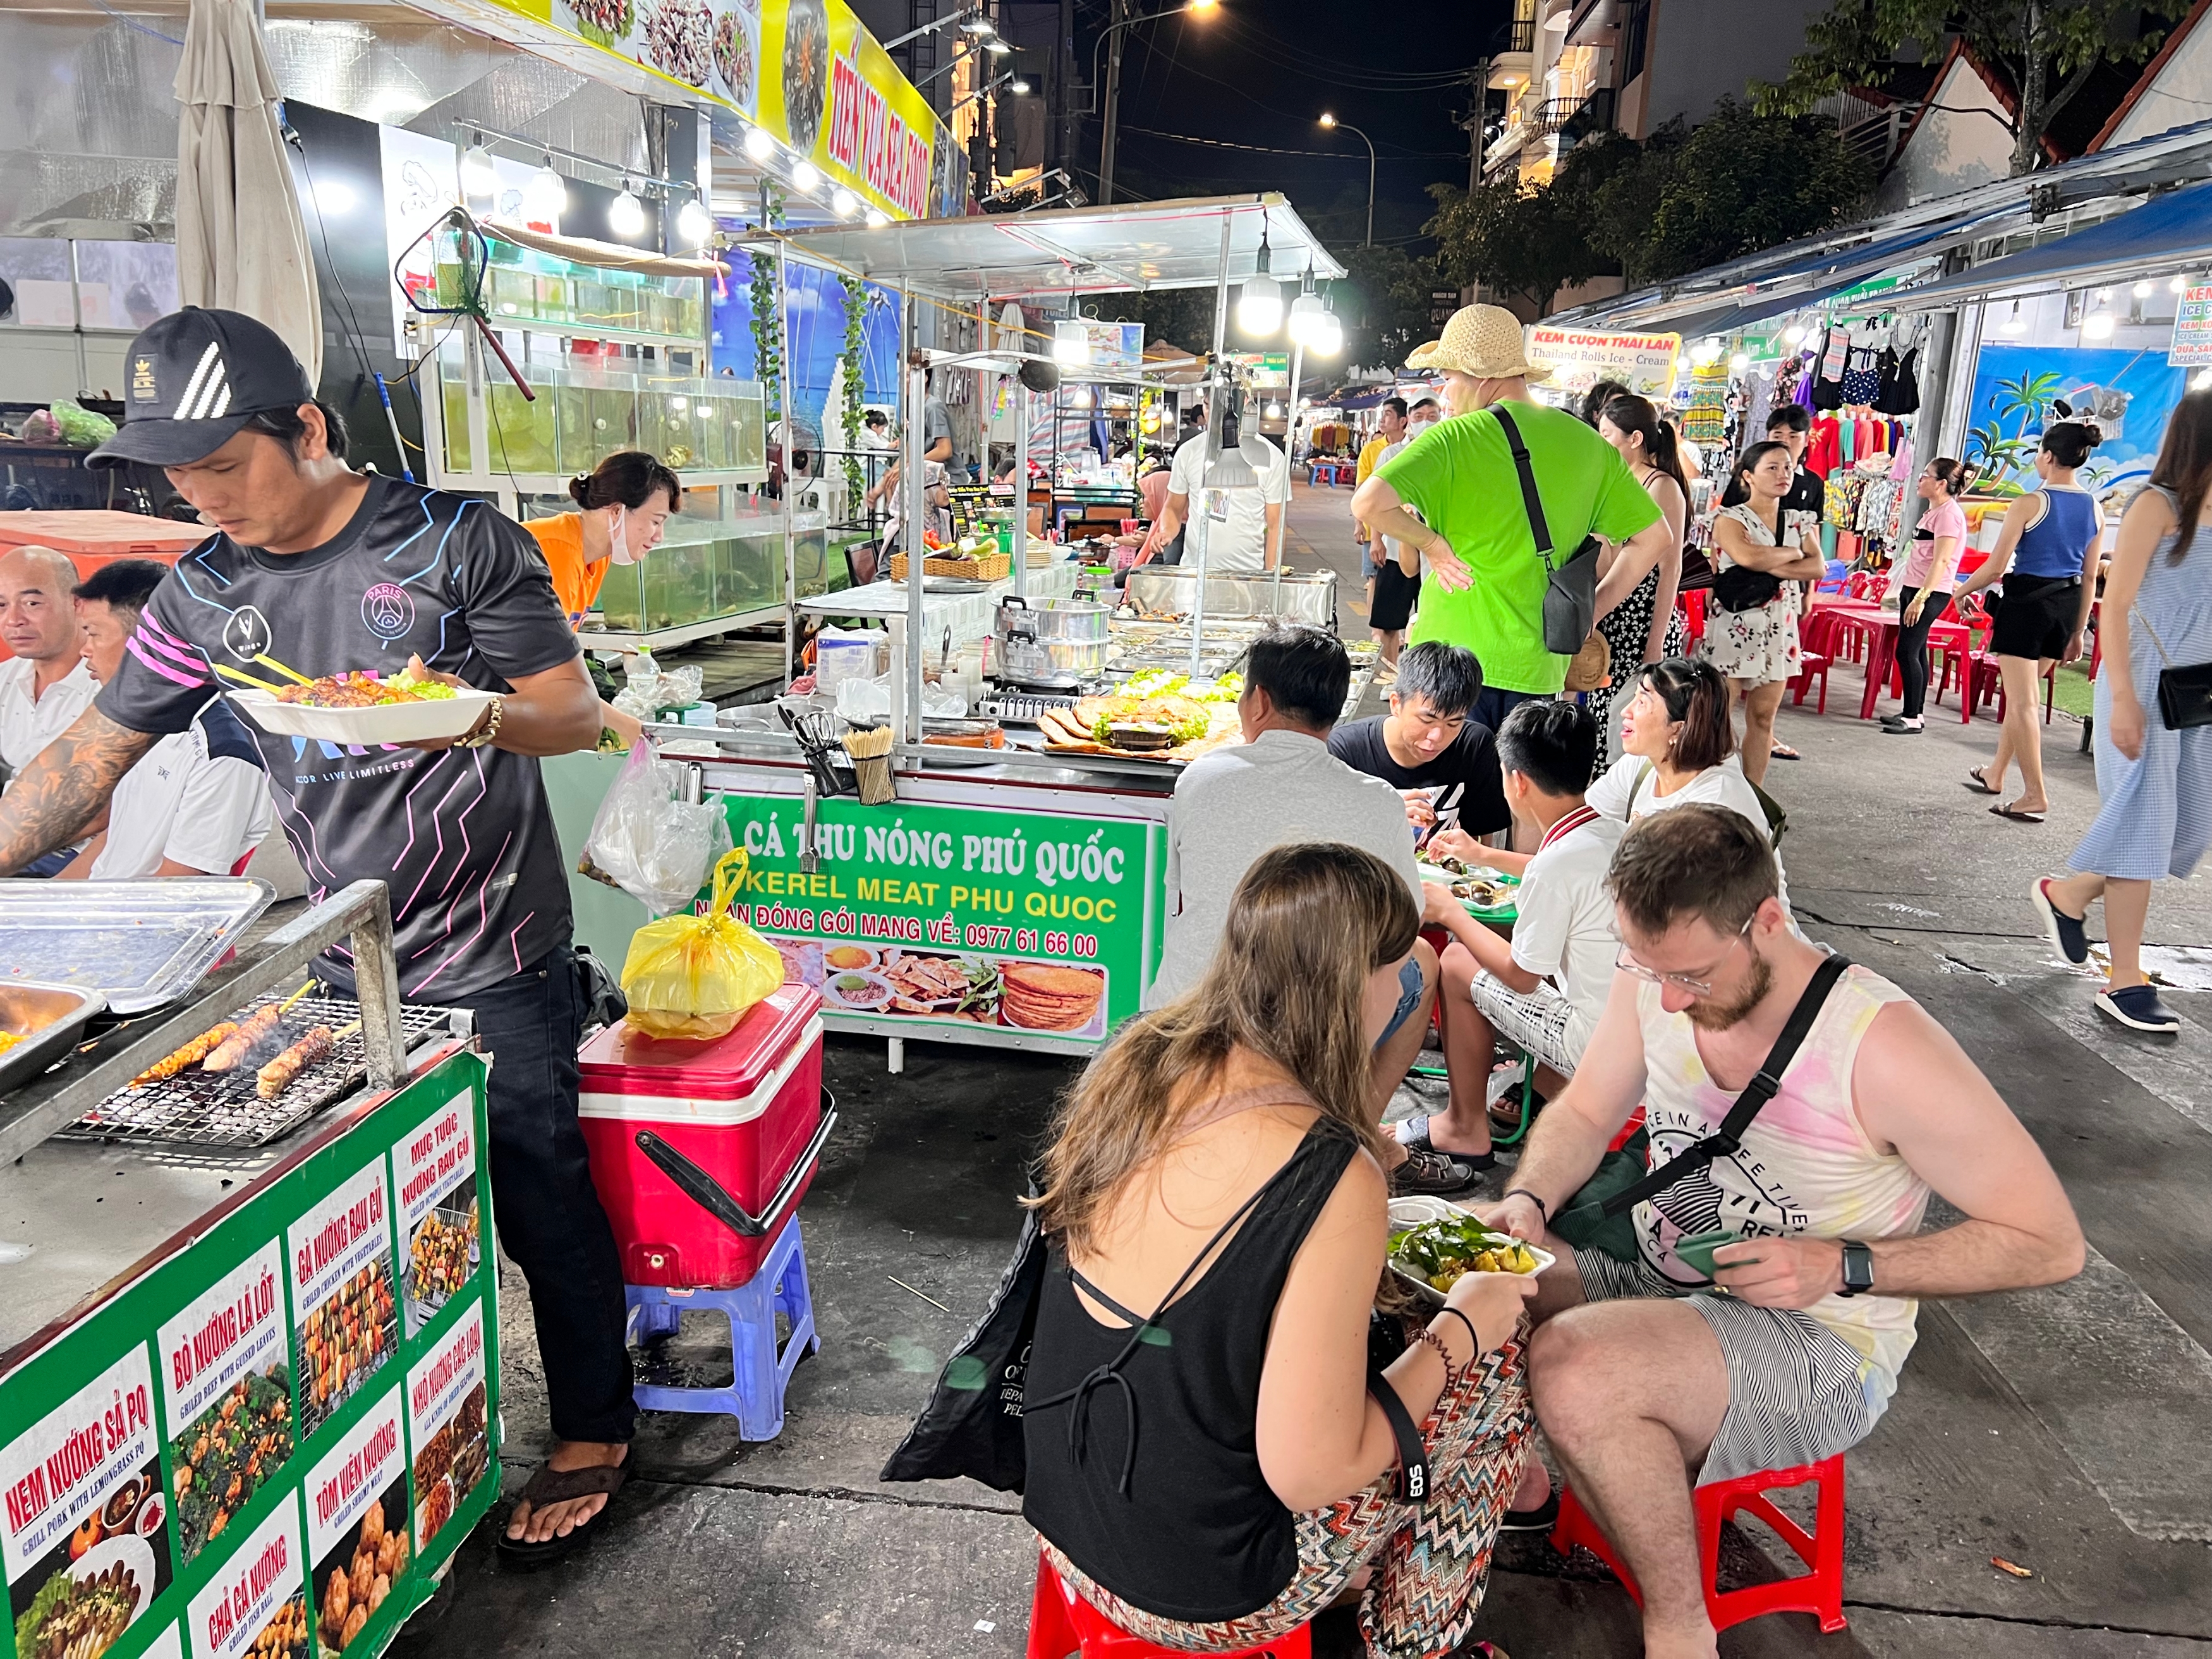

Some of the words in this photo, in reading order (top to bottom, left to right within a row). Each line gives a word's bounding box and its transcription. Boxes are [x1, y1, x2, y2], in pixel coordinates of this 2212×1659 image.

[884, 108, 906, 210] SEA
[902, 127, 929, 219] FOOD
[1534, 331, 1564, 343] KEM
[1645, 339, 1674, 351] LAN
[2180, 321, 2199, 329] KEM
[2182, 305, 2201, 315] ICE
[1532, 348, 1576, 360] Thailand
[1581, 351, 1605, 362] Rolls
[1610, 353, 1625, 363] Ice
[1636, 354, 1670, 366] Cream
[367, 586, 402, 600] PARIS
[322, 770, 346, 782] LIVE
[349, 758, 415, 780] LIMITLESS
[744, 811, 786, 857] CÁ
[864, 818, 954, 870] NÓNG
[962, 828, 1027, 876] PHÚ
[1035, 828, 1124, 887] QUỐC
[756, 901, 814, 933] ĐÓNG
[820, 905, 856, 934] GÓI
[861, 913, 921, 942] MANG
[926, 911, 961, 945] VỀ:
[965, 922, 1012, 949] 0977
[1016, 927, 1038, 952] 61
[1044, 930, 1069, 955] 66
[1073, 932, 1098, 957] 00
[858, 877, 940, 906] MEAT
[951, 885, 1014, 914] PHU
[1024, 892, 1117, 923] QUOC
[411, 1132, 434, 1166] MỰC
[1668, 1111, 1689, 1127] IN
[1698, 1122, 1708, 1134] A
[402, 1164, 437, 1208] NƯỚNG
[437, 1146, 456, 1178] RAU
[457, 1130, 470, 1162] CỦ
[425, 1186, 442, 1206] OCTOPUS
[442, 1165, 465, 1190] VEGETABLES
[298, 1237, 314, 1287] GÀ
[313, 1214, 349, 1274] NƯỚNG
[349, 1197, 368, 1244] RAU
[369, 1176, 383, 1227] CỦ
[303, 1286, 320, 1310] GRILED
[321, 1268, 341, 1294] CHICKEN
[342, 1257, 354, 1276] WITH
[355, 1232, 382, 1265] VEGETABLES
[173, 1334, 193, 1394] BÒ
[193, 1306, 238, 1376] NƯỚNG
[238, 1284, 254, 1339] LÁ
[254, 1263, 275, 1325] LỐT
[180, 1393, 202, 1420] GRILED
[204, 1377, 218, 1401] BEEF
[220, 1364, 234, 1385] WITH
[235, 1345, 255, 1370] GUISED
[256, 1326, 276, 1352] LEAVES
[413, 1370, 429, 1421] KHÔ
[428, 1351, 453, 1403] NƯỚNG
[453, 1332, 466, 1376] CÁC
[423, 1418, 432, 1432] ALL
[432, 1404, 443, 1425] KINDS
[443, 1397, 449, 1410] OF
[448, 1385, 459, 1403] DRIED
[459, 1367, 475, 1390] SEAFOOD
[5, 1464, 49, 1538] NEM
[46, 1420, 106, 1504] NƯỚNG
[104, 1389, 128, 1455] SẢ
[126, 1384, 149, 1437] PQ
[316, 1475, 339, 1529] TÔM
[339, 1450, 363, 1504] VIÊN
[363, 1418, 397, 1480] NƯỚNG
[1409, 1464, 1423, 1497] EOS
[22, 1531, 47, 1557] GRILL
[47, 1508, 68, 1536] PORK
[69, 1492, 89, 1518] WITH
[90, 1452, 134, 1500] LEMONGRASS
[135, 1440, 145, 1463] PQ
[334, 1504, 351, 1529] GRILED
[352, 1484, 370, 1510] SHRIMP
[370, 1469, 383, 1490] MEAT
[209, 1585, 234, 1653] CHẢ
[233, 1569, 251, 1624] CÁ
[250, 1534, 288, 1607] NƯỚNG
[229, 1624, 248, 1653] GRILED
[248, 1608, 260, 1629] FISH
[260, 1591, 274, 1613] BALL
